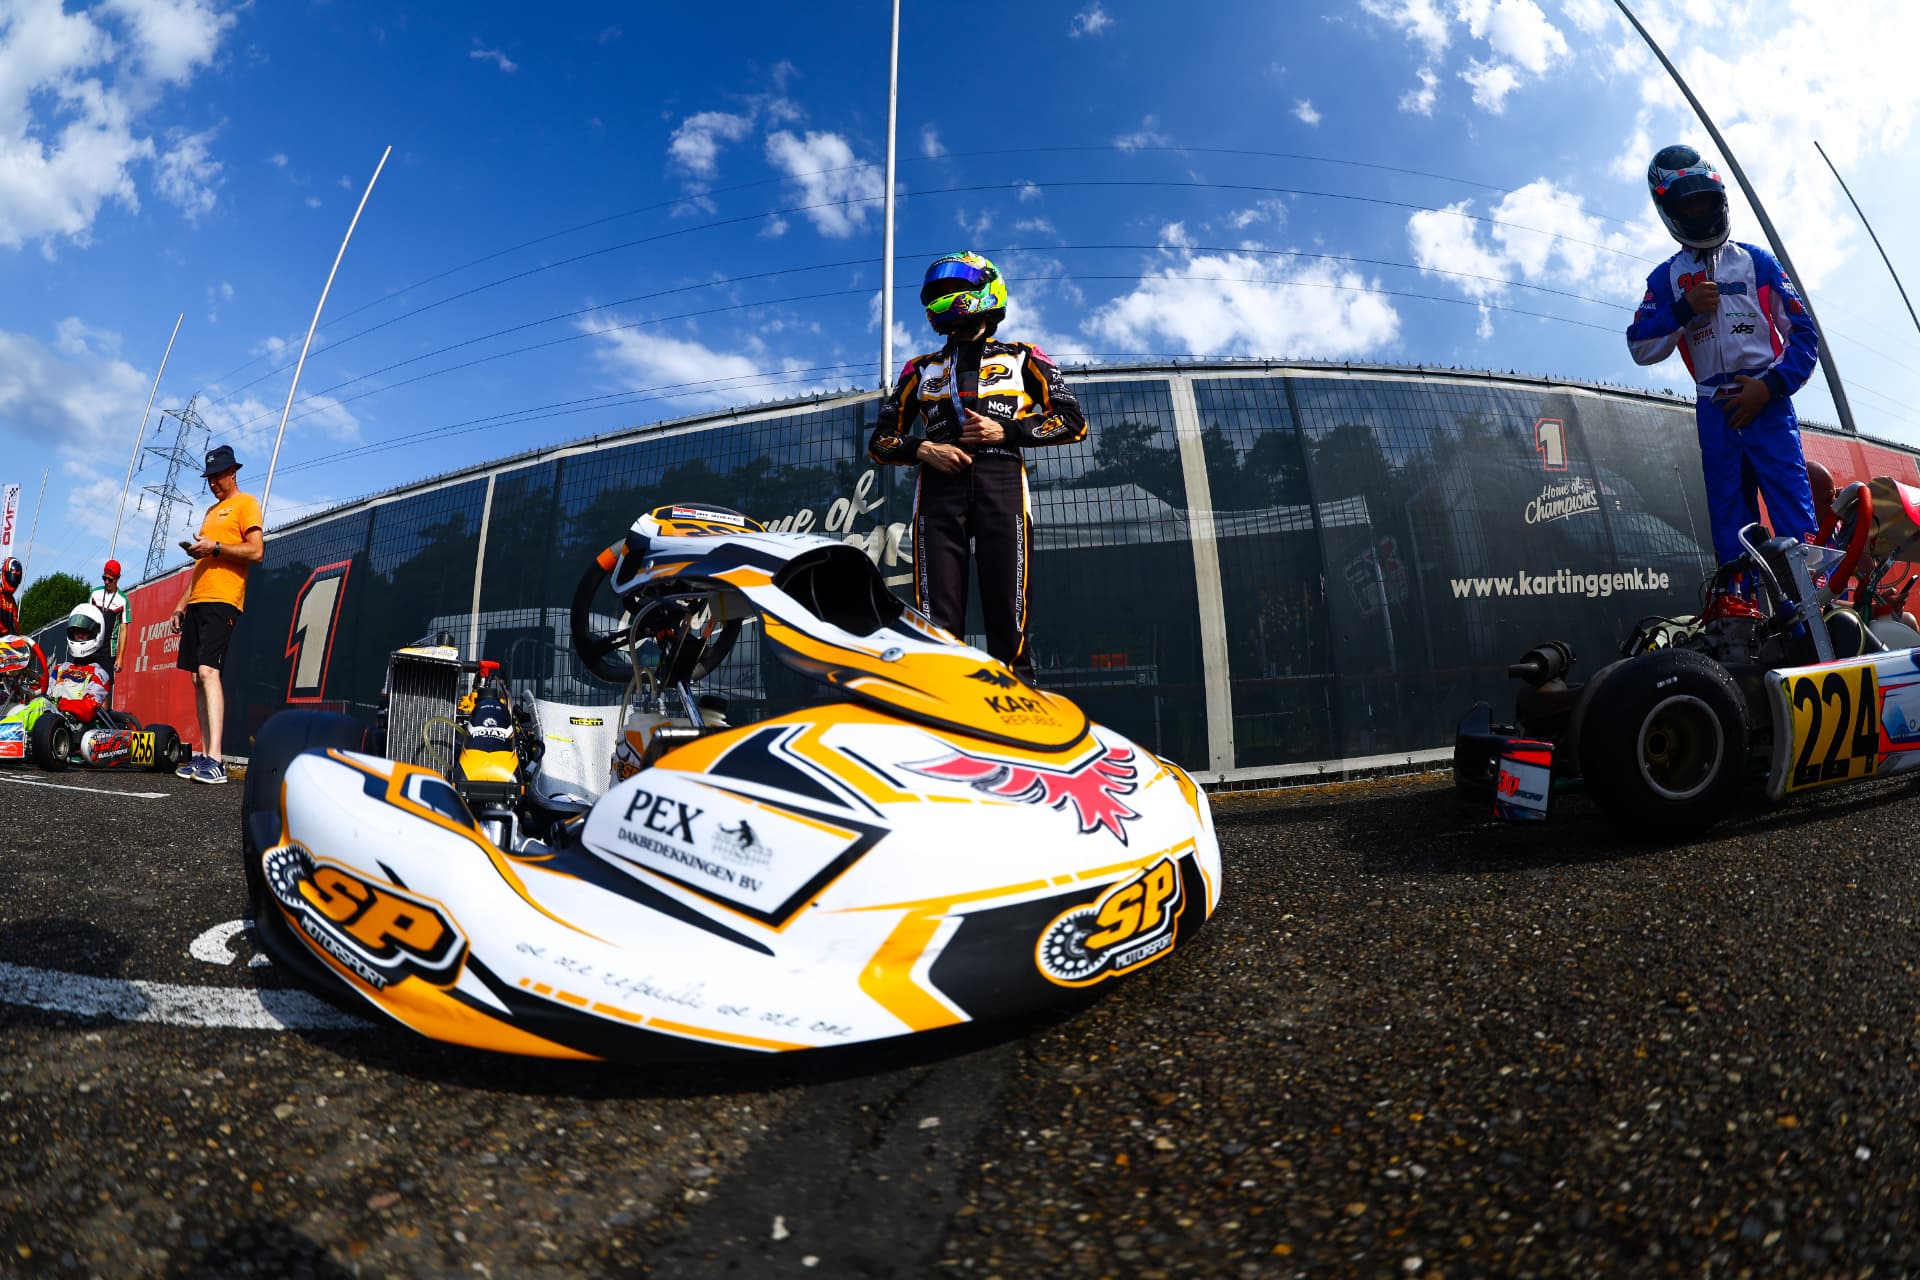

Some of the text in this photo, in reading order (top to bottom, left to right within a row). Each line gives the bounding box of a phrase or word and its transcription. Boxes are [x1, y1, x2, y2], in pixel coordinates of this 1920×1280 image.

[988, 401, 1012, 415] NGK
[1537, 420, 1565, 468] 1
[824, 469, 887, 533] of
[1525, 490, 1598, 524] Champions
[1541, 476, 1585, 500] Home of
[1451, 567, 1669, 598] www.kartinggenk.be
[290, 567, 346, 695] 1
[984, 695, 1048, 716] KART
[1792, 667, 1880, 788] 224
[132, 733, 153, 762] 256
[472, 729, 508, 740] ROTAX
[624, 788, 704, 844] PEX
[617, 827, 736, 883] DAKBEDEKKINGEN
[738, 873, 764, 892] BV
[298, 866, 446, 952] SP
[1083, 860, 1175, 950] SP
[301, 915, 390, 992] MOTORSPORT
[1115, 932, 1173, 968] MOTORSPORT
